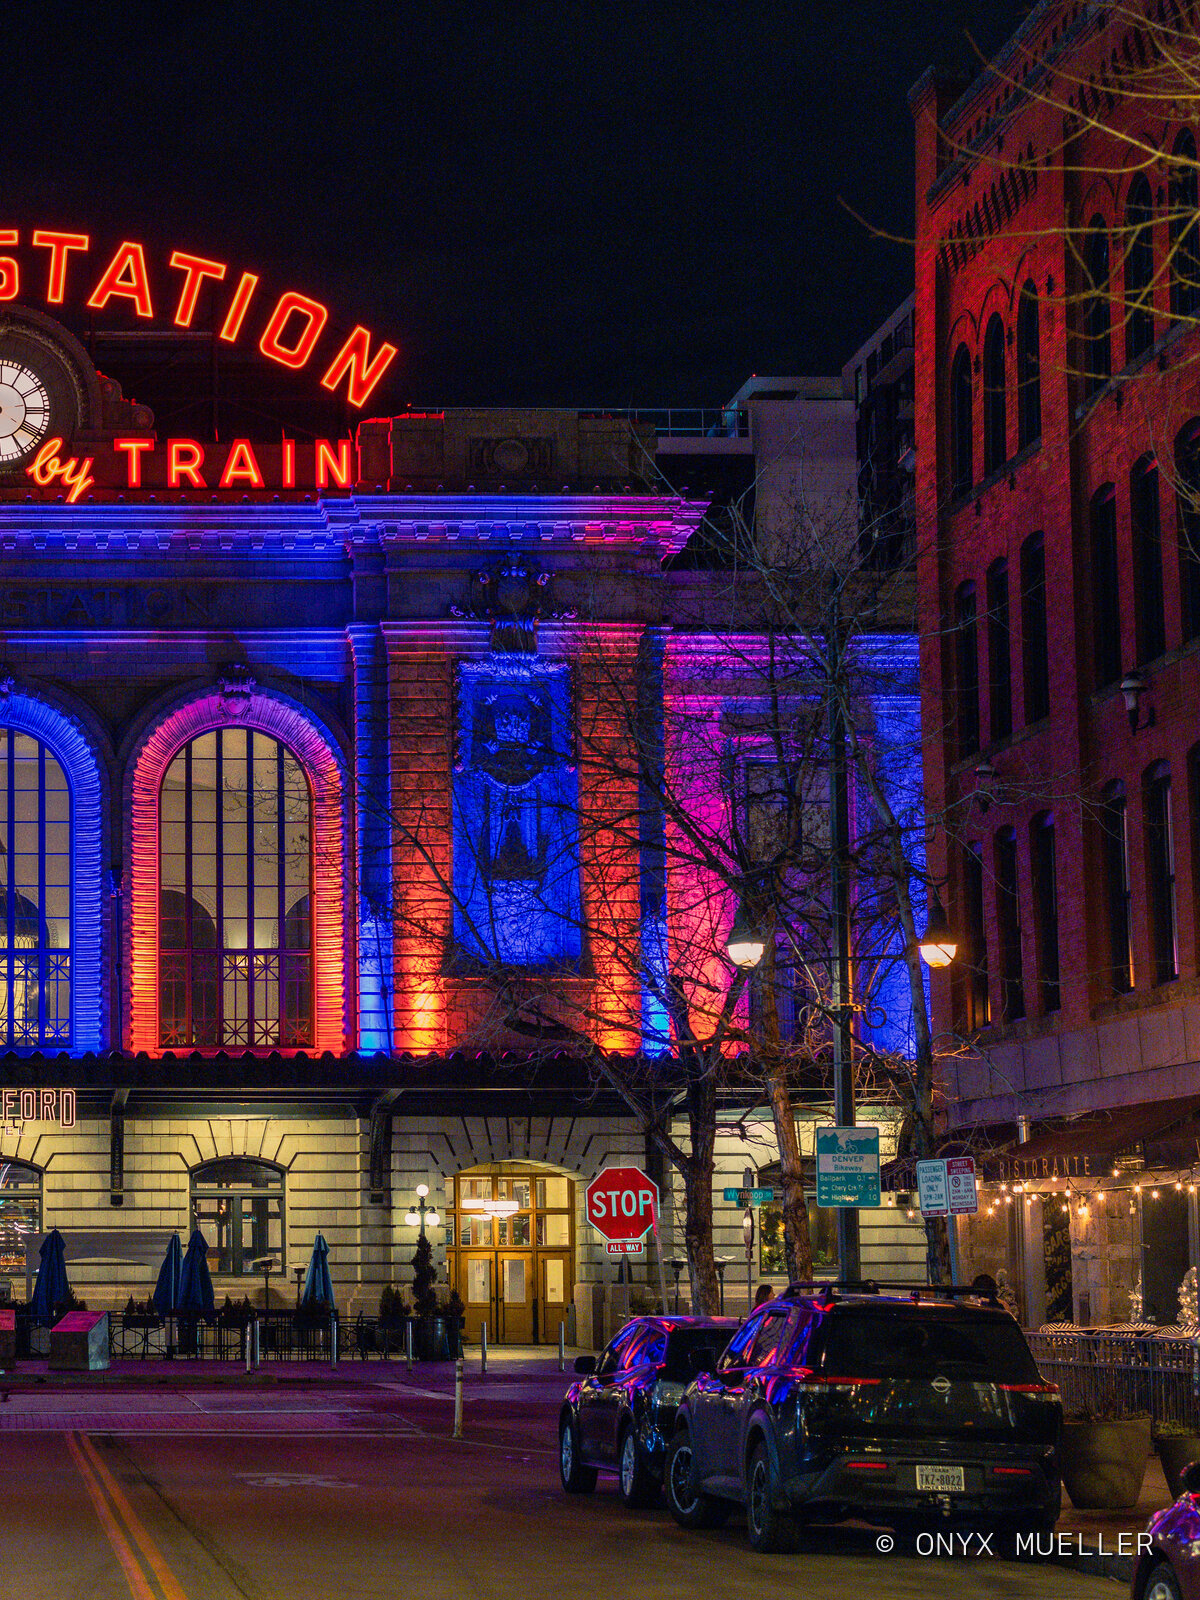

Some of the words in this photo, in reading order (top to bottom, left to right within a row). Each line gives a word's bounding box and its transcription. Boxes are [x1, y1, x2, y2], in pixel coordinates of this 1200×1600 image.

[26, 436, 94, 503] by
[113, 437, 352, 489] TRAIN
[832, 1155, 864, 1163] DENVER
[834, 1164, 863, 1172] Bikeway
[919, 1165, 943, 1174] PASSENGER
[999, 1156, 1091, 1179] RISTORANTE
[820, 1174, 846, 1182] Ballpark
[921, 1175, 942, 1184] LOADING
[727, 1190, 764, 1200] Wynkoop
[591, 1189, 654, 1218] STOP
[610, 1244, 623, 1252] ALL
[626, 1243, 640, 1251] WAY
